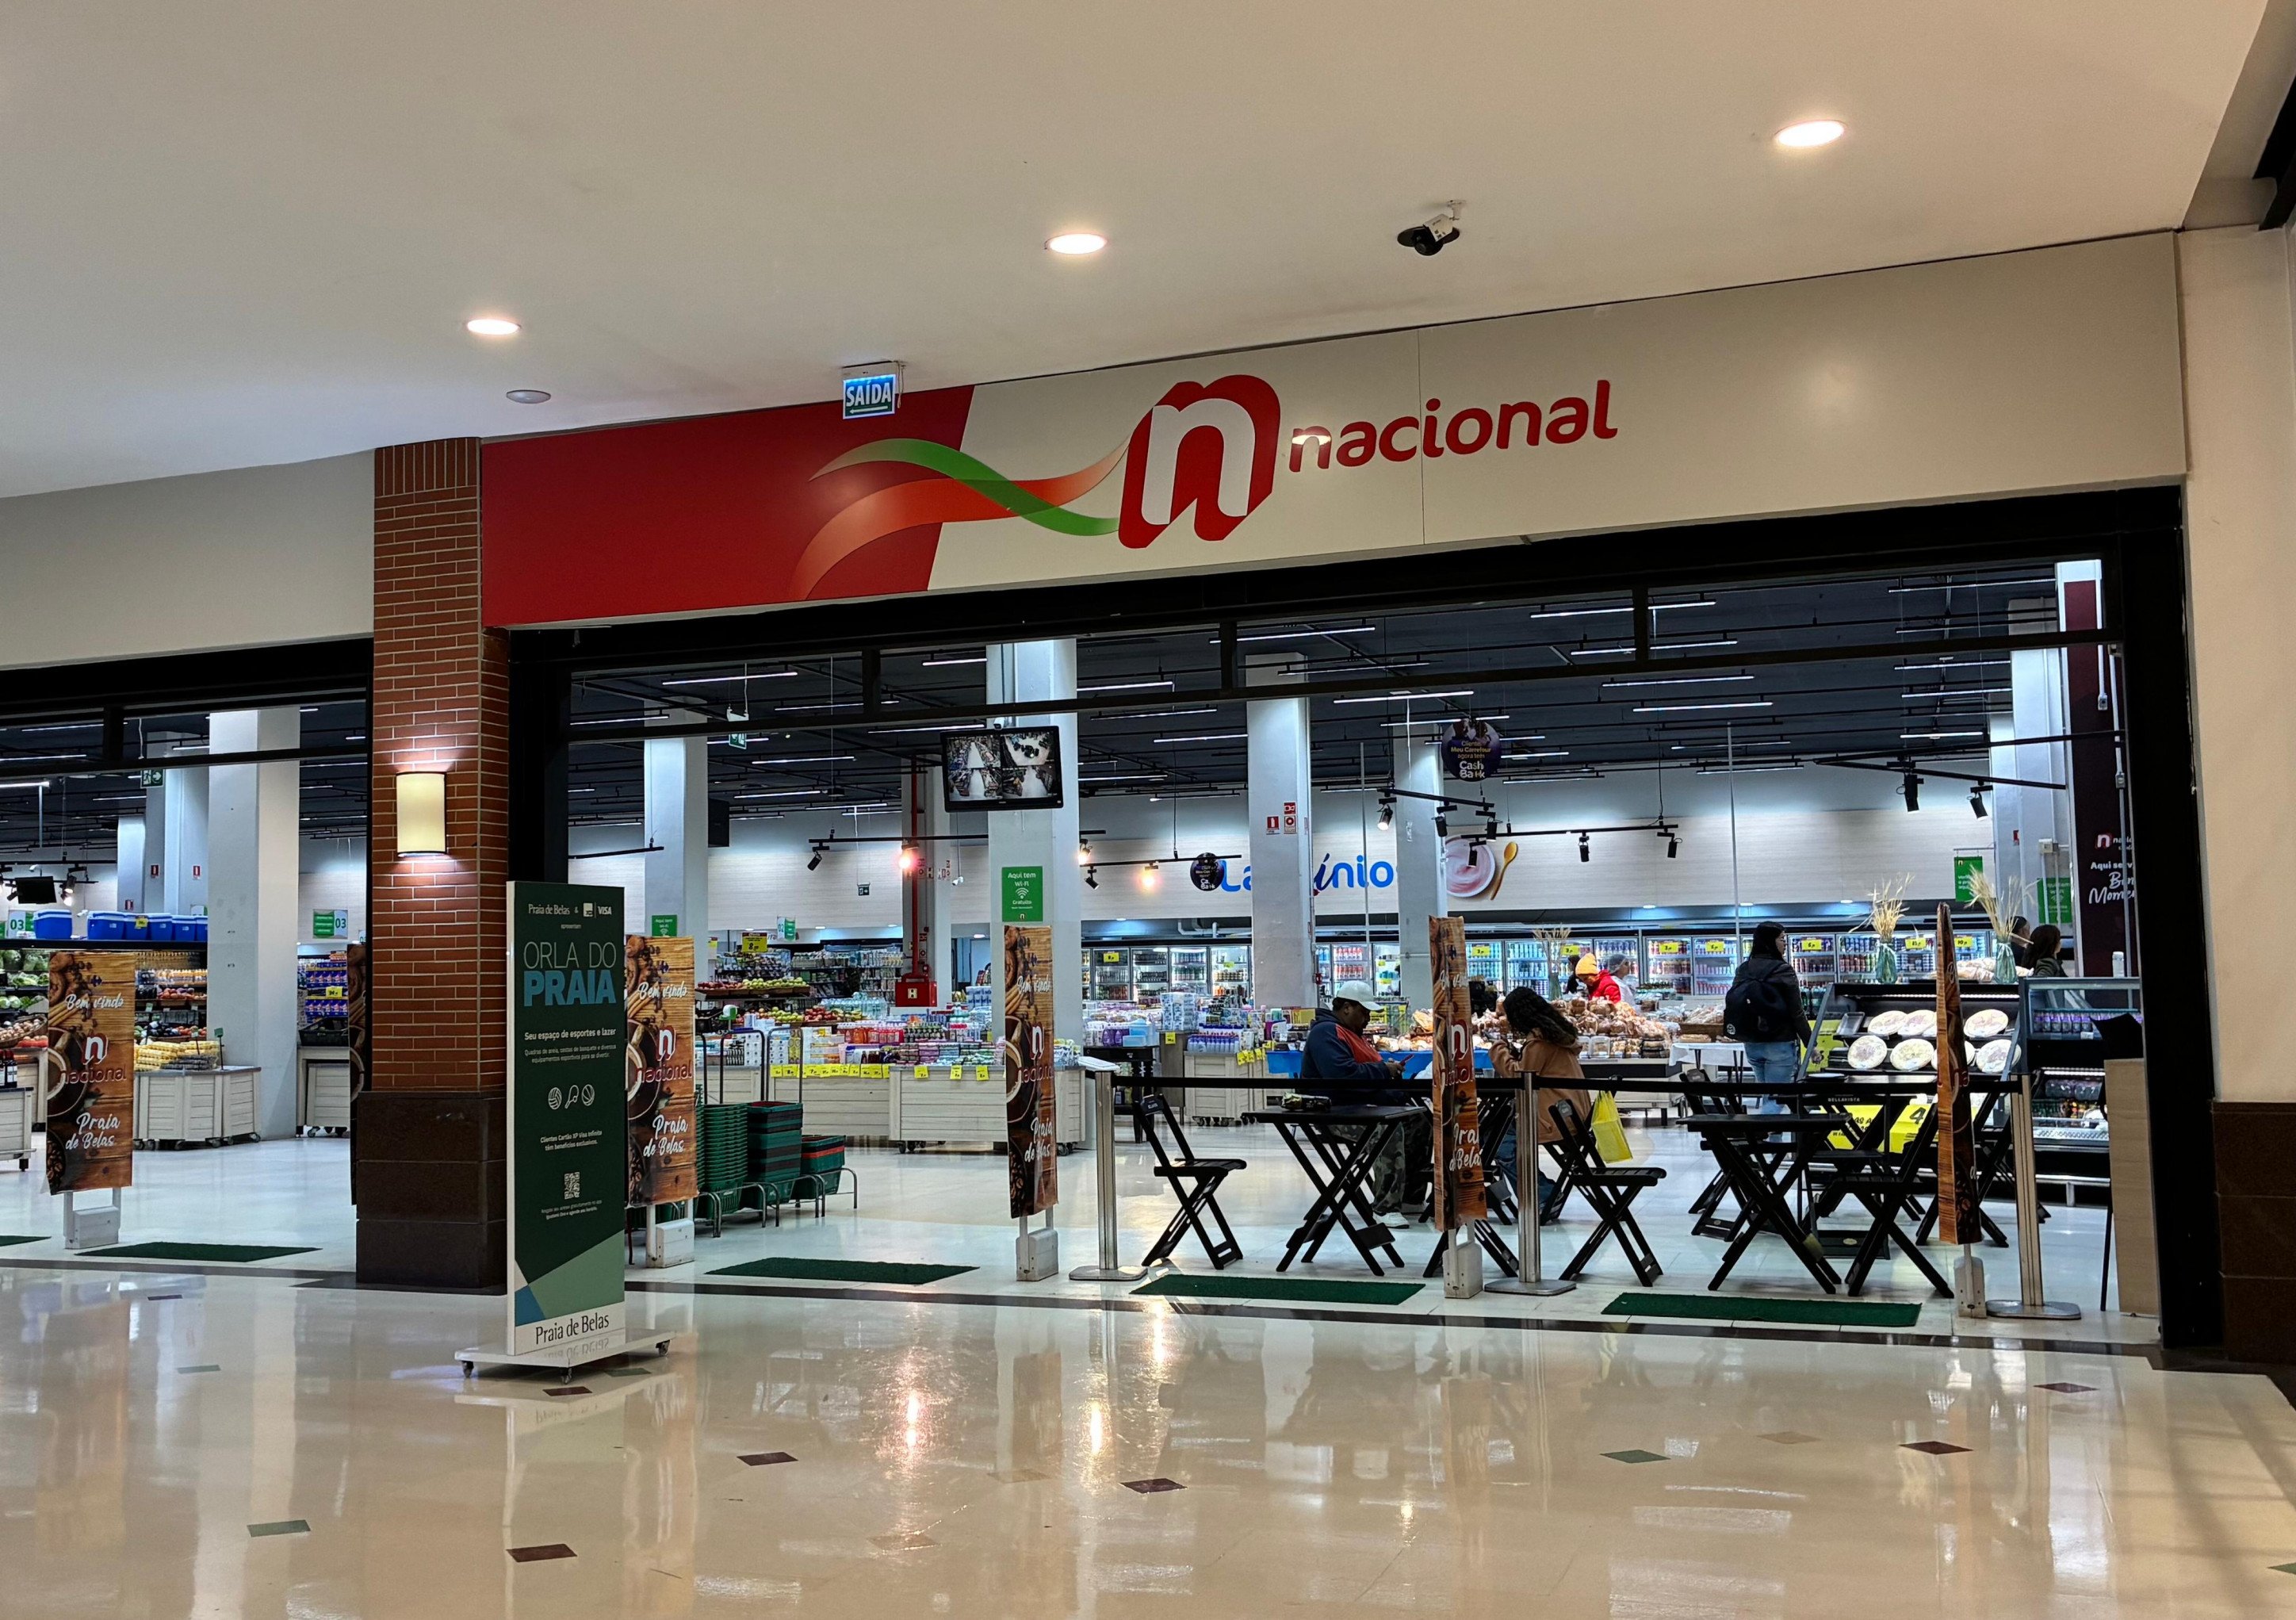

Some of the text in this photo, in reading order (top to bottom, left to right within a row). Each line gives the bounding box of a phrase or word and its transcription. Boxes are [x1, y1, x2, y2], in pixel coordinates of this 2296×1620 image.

[846, 381, 891, 406] SAÍDA
[1288, 379, 1619, 474] nacional
[1460, 760, 1484, 770] Cash
[2091, 861, 2111, 871] Aqui
[528, 904, 544, 914] Praia
[545, 905, 553, 914] de
[553, 904, 570, 914] Belas
[598, 906, 612, 915] VISA
[10, 920, 24, 930] 03
[335, 918, 346, 929] 03
[523, 941, 617, 970] ORLA DO
[523, 969, 617, 1007] PRAIA
[638, 982, 660, 999] Bem
[65, 993, 124, 1009] Bem vindo
[538, 1032, 560, 1041] espaço
[570, 1029, 595, 1039] esportes
[602, 1027, 616, 1036] lazer
[61, 1064, 127, 1085] nacional
[636, 1059, 693, 1083] nacional
[76, 1112, 121, 1134] Praia
[652, 1115, 688, 1139] Praia
[65, 1131, 115, 1150] de Belas
[643, 1136, 684, 1157] de Belas
[1456, 1146, 1482, 1170] Bela
[536, 1312, 609, 1345] Praia de Belas
